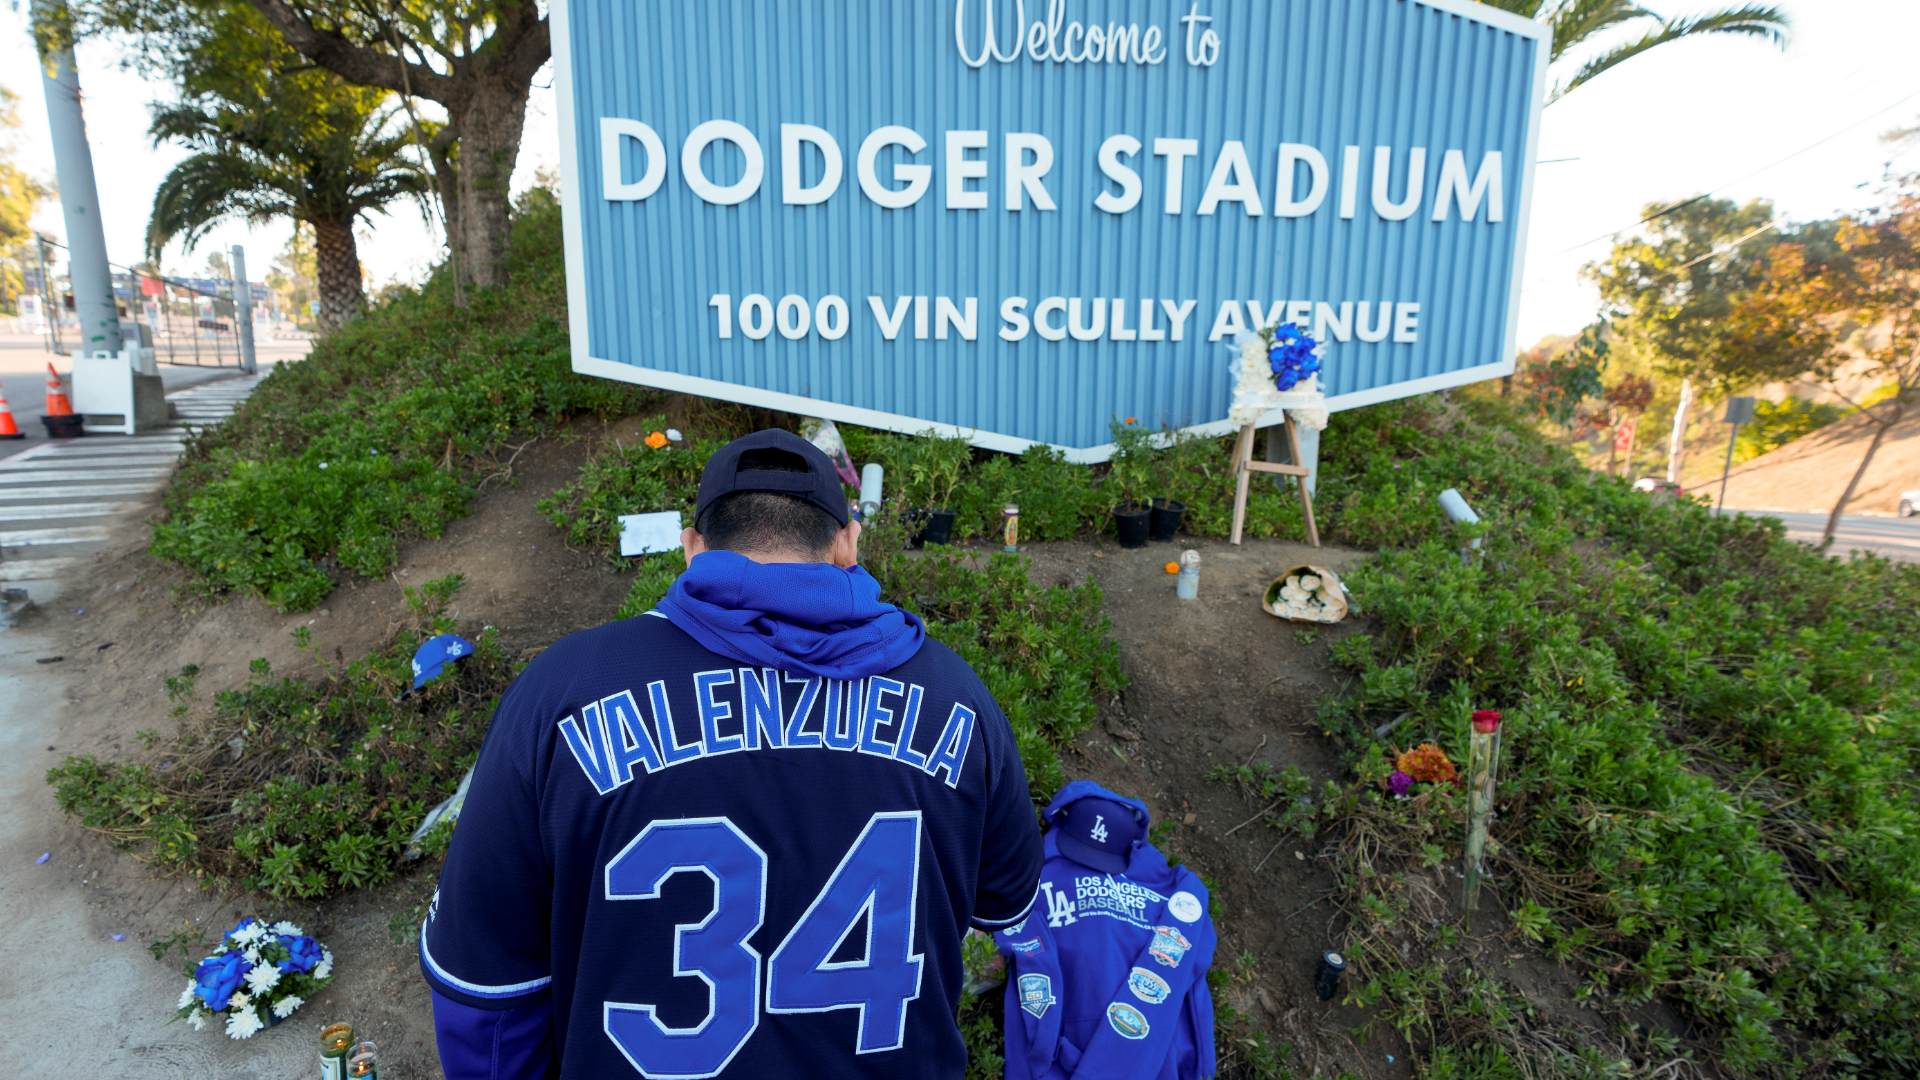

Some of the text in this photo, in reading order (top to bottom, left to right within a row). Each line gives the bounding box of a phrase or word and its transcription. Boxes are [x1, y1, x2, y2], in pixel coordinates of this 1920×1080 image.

[955, 0, 1220, 67] Welcome to
[600, 117, 1504, 223] DODGER STADIUM
[709, 294, 1420, 343] 1000 VIN SCULLY AVENUE
[557, 667, 976, 795] VALENZUELA
[1090, 815, 1108, 843] LA
[1040, 881, 1078, 928] LA
[1075, 876, 1101, 888] LOS
[1077, 886, 1146, 909] DODGERS
[604, 811, 925, 1079] 34
